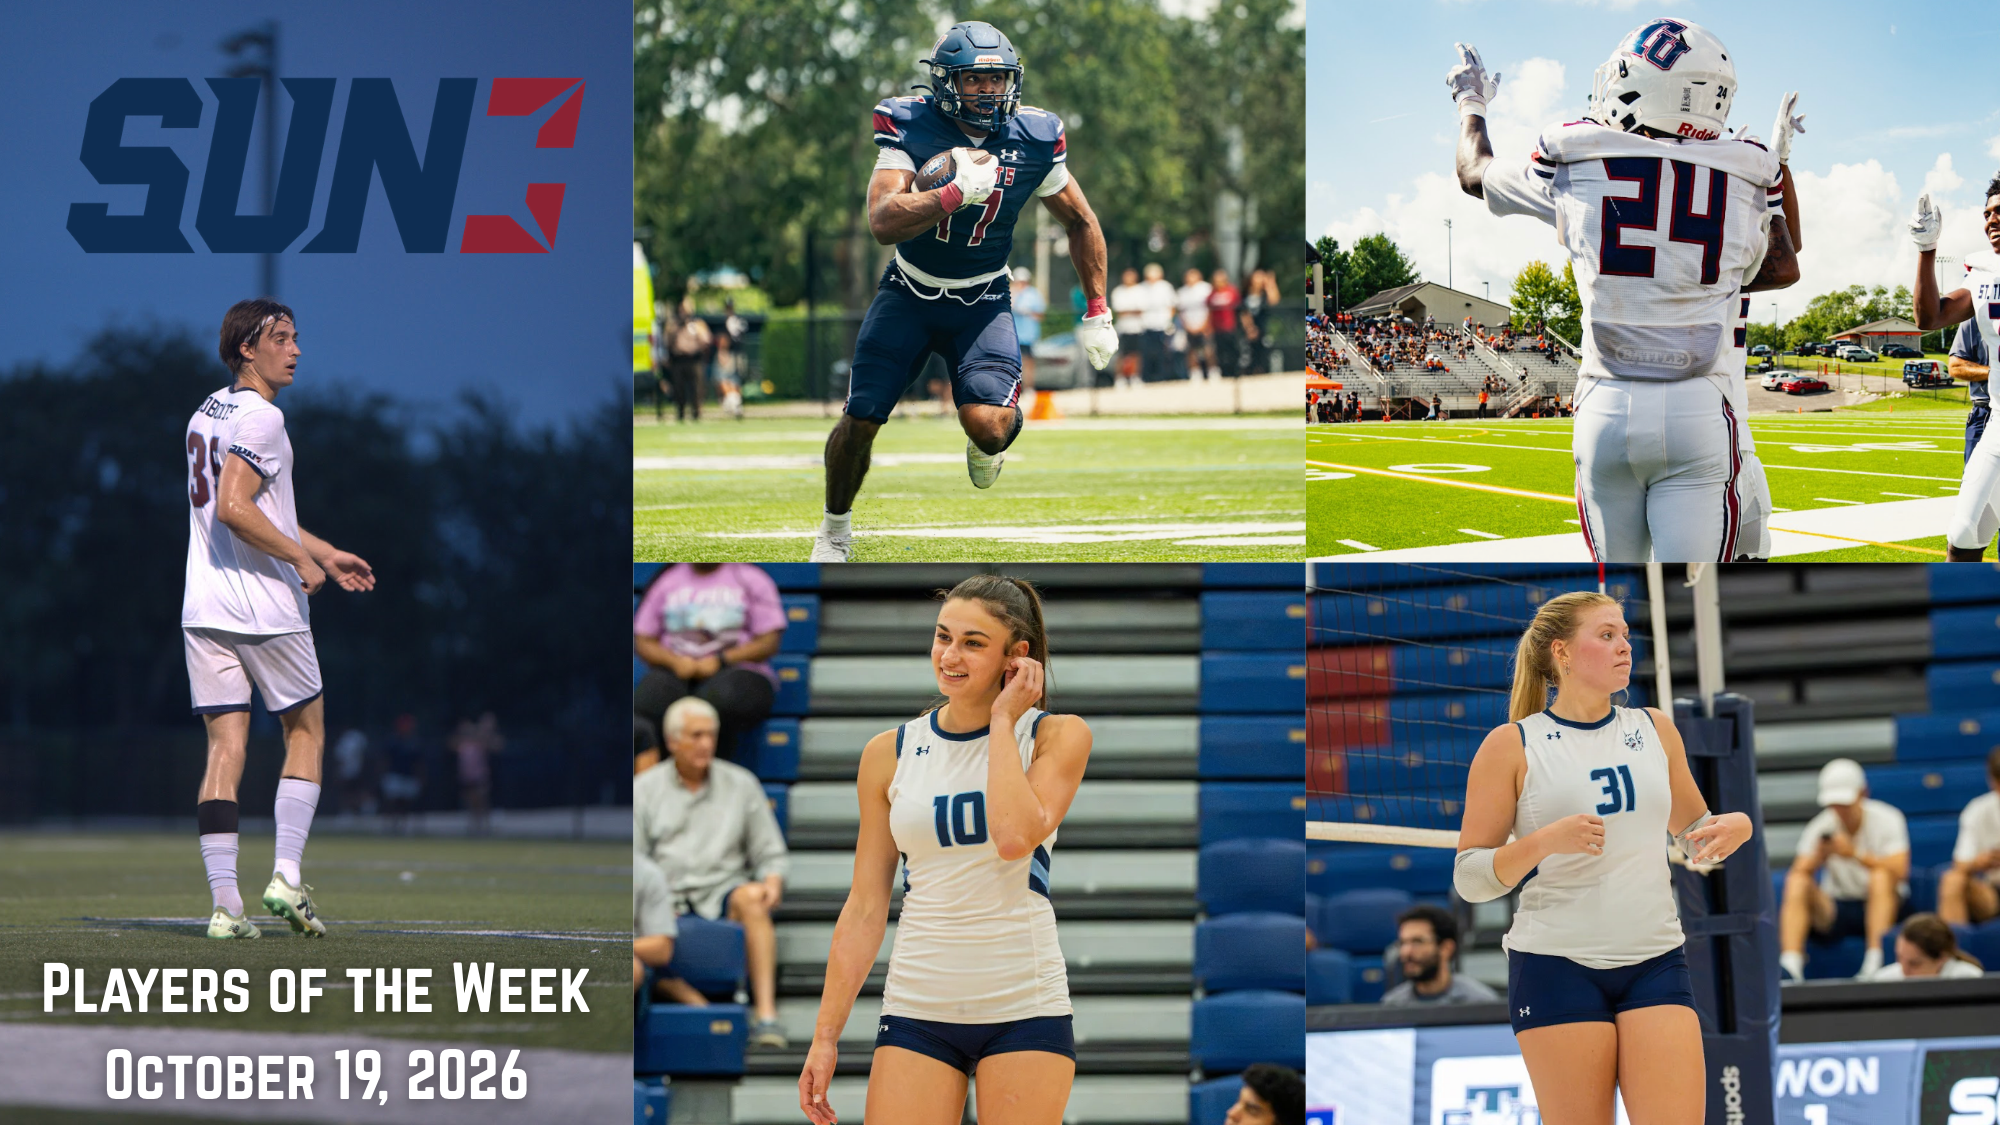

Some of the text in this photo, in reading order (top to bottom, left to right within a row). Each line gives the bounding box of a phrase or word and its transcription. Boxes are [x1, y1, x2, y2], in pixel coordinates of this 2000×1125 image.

[1716, 85, 1728, 99] 24
[1599, 157, 1728, 285] 24
[1590, 764, 1637, 816] 31
[932, 790, 989, 848] 10
[1776, 1056, 1880, 1098] WON
